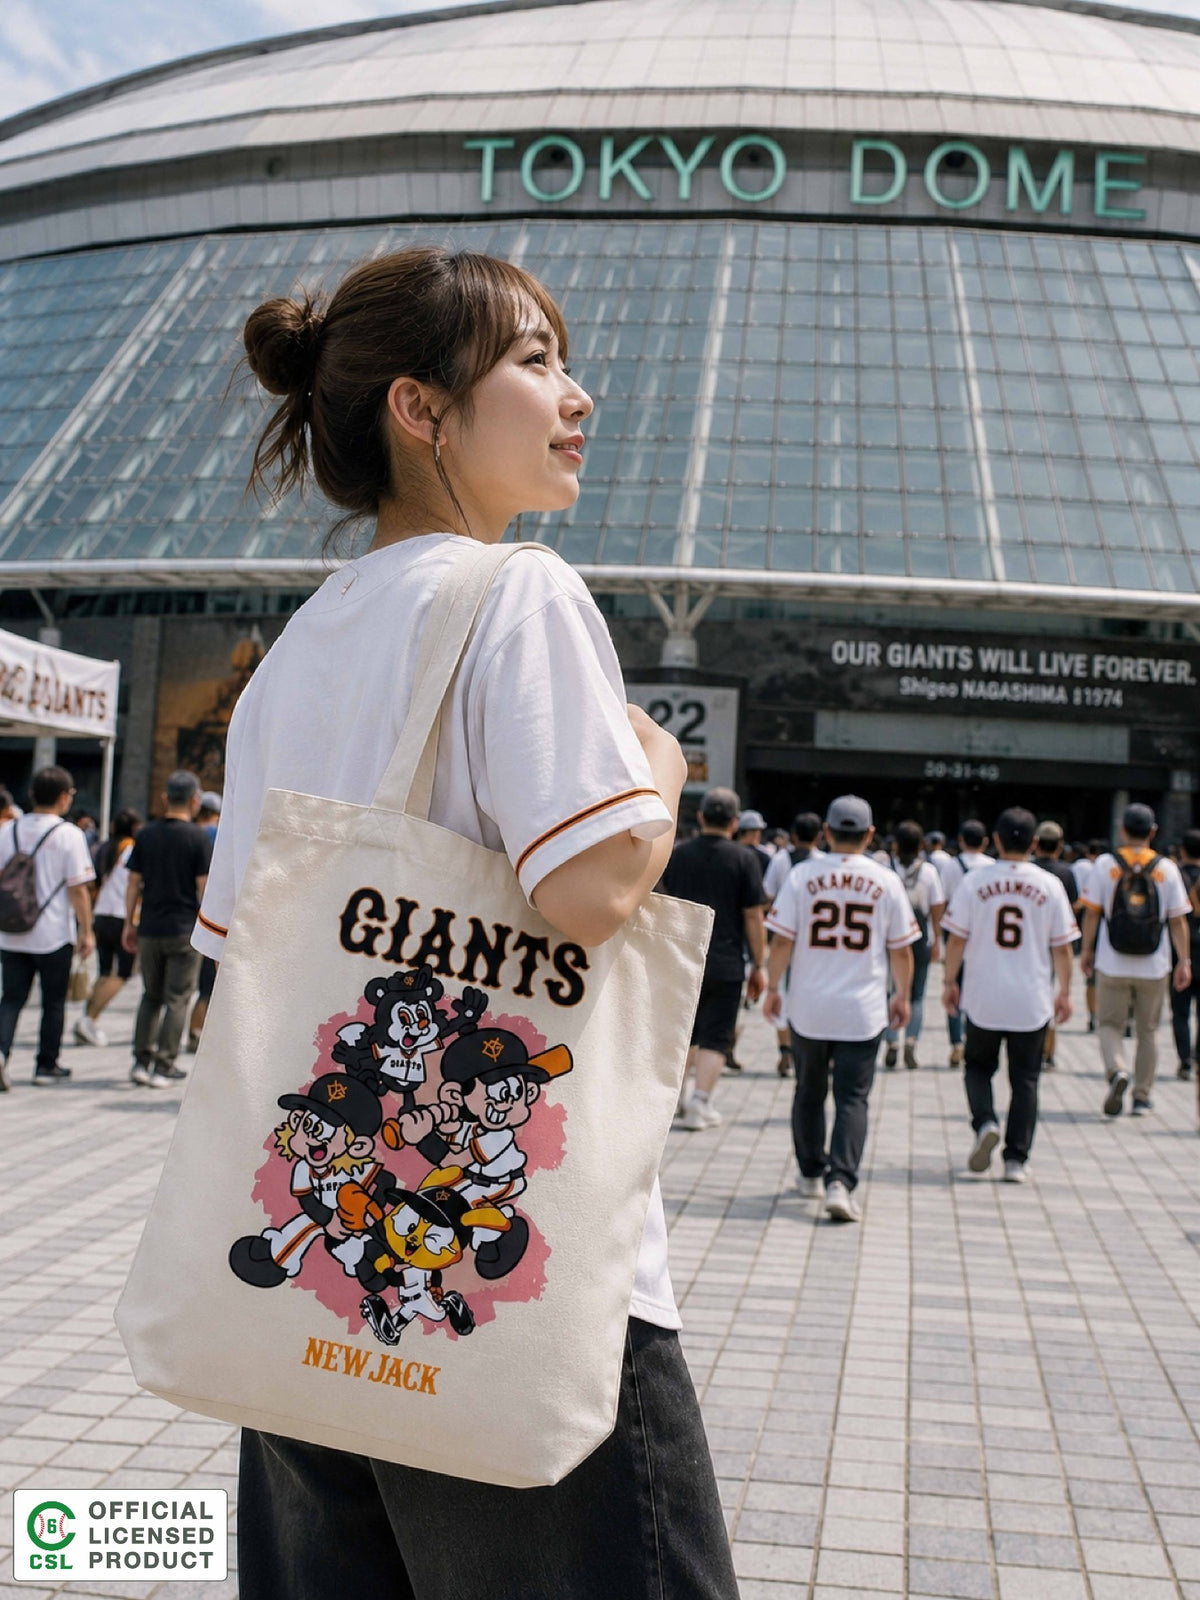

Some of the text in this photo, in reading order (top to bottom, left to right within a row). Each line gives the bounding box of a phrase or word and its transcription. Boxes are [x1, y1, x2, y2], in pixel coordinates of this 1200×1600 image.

[464, 134, 1148, 220] TOKYO DOME
[831, 640, 1197, 686] OUR GIANTS WILL LIVE FOREVER.
[806, 873, 884, 900] OKAMOTO
[339, 886, 591, 1007] GIANTS
[809, 900, 875, 953] 25
[995, 904, 1024, 951] 6
[301, 1336, 442, 1395] NEW JACK
